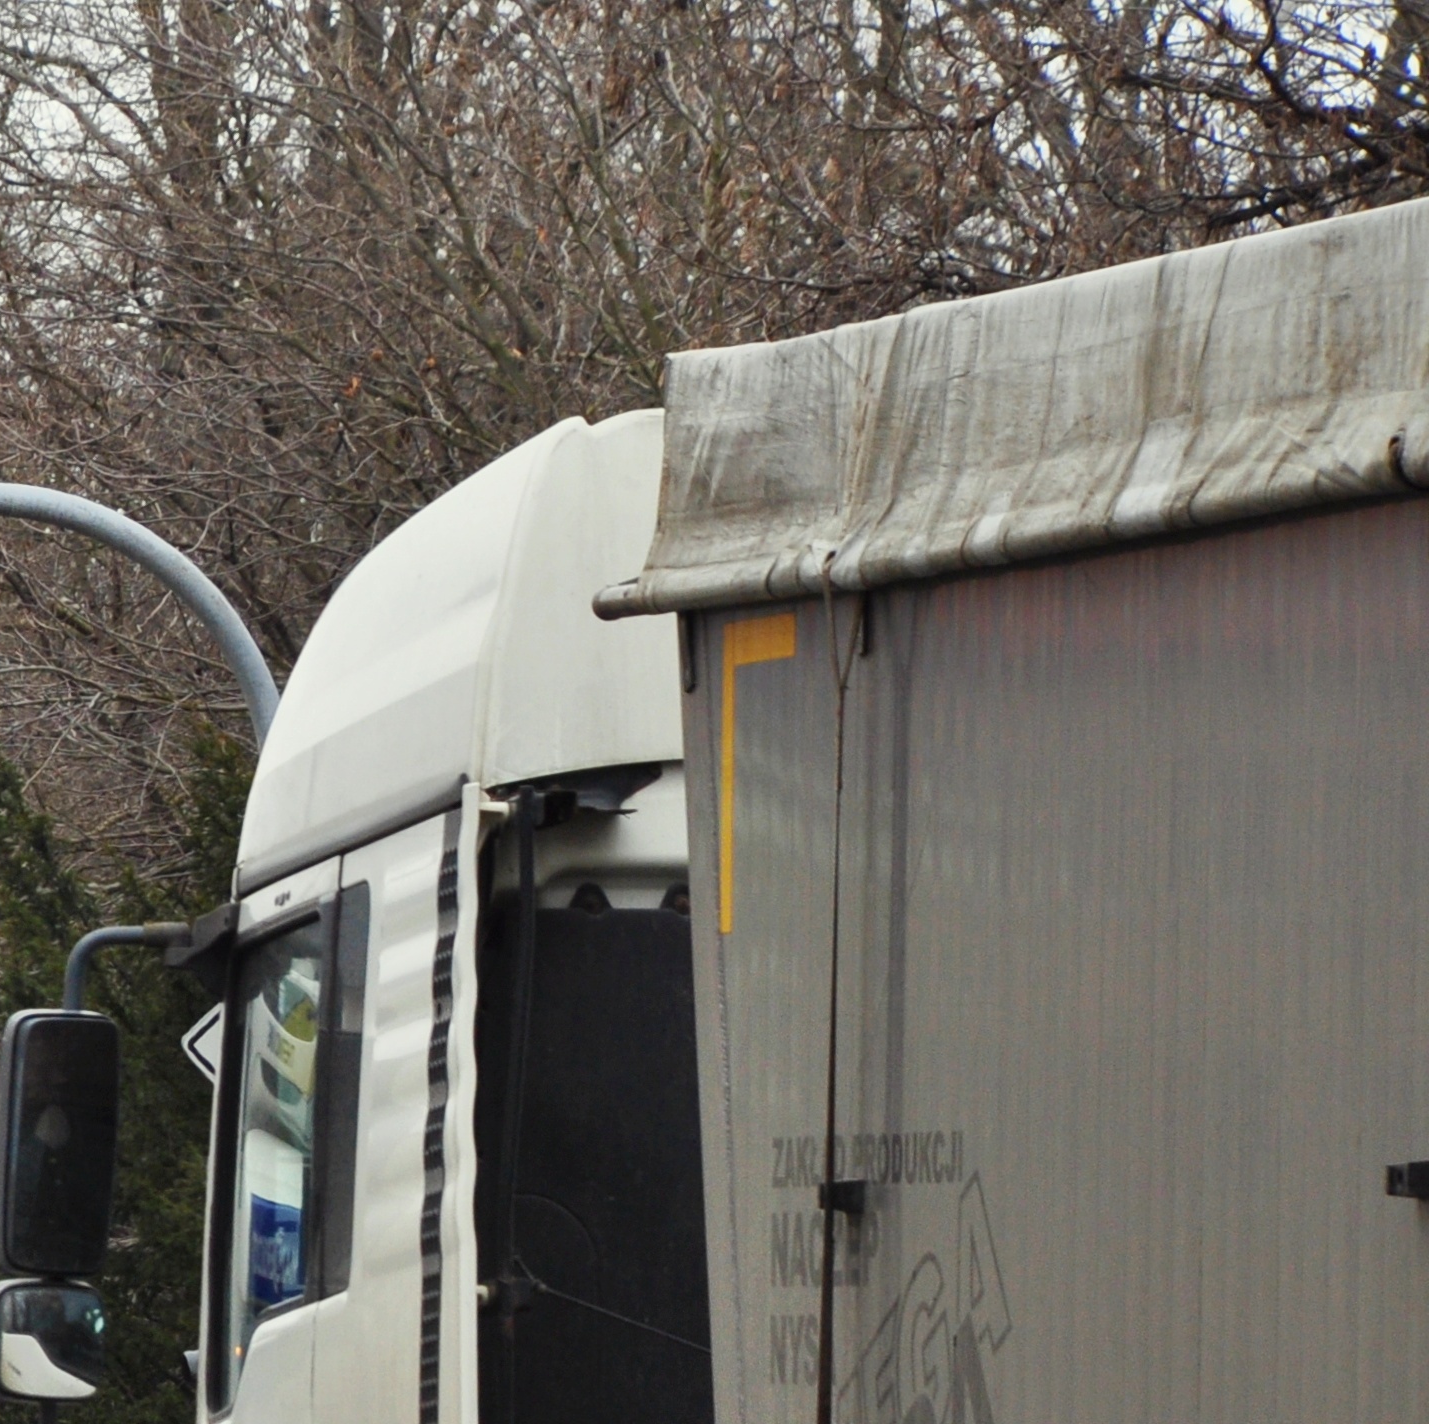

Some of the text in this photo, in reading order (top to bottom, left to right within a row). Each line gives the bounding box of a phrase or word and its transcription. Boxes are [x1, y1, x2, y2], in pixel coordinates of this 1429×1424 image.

[771, 1129, 964, 1188] ZAKŁD PRODUKCJI
[770, 1313, 835, 1387] NYS
